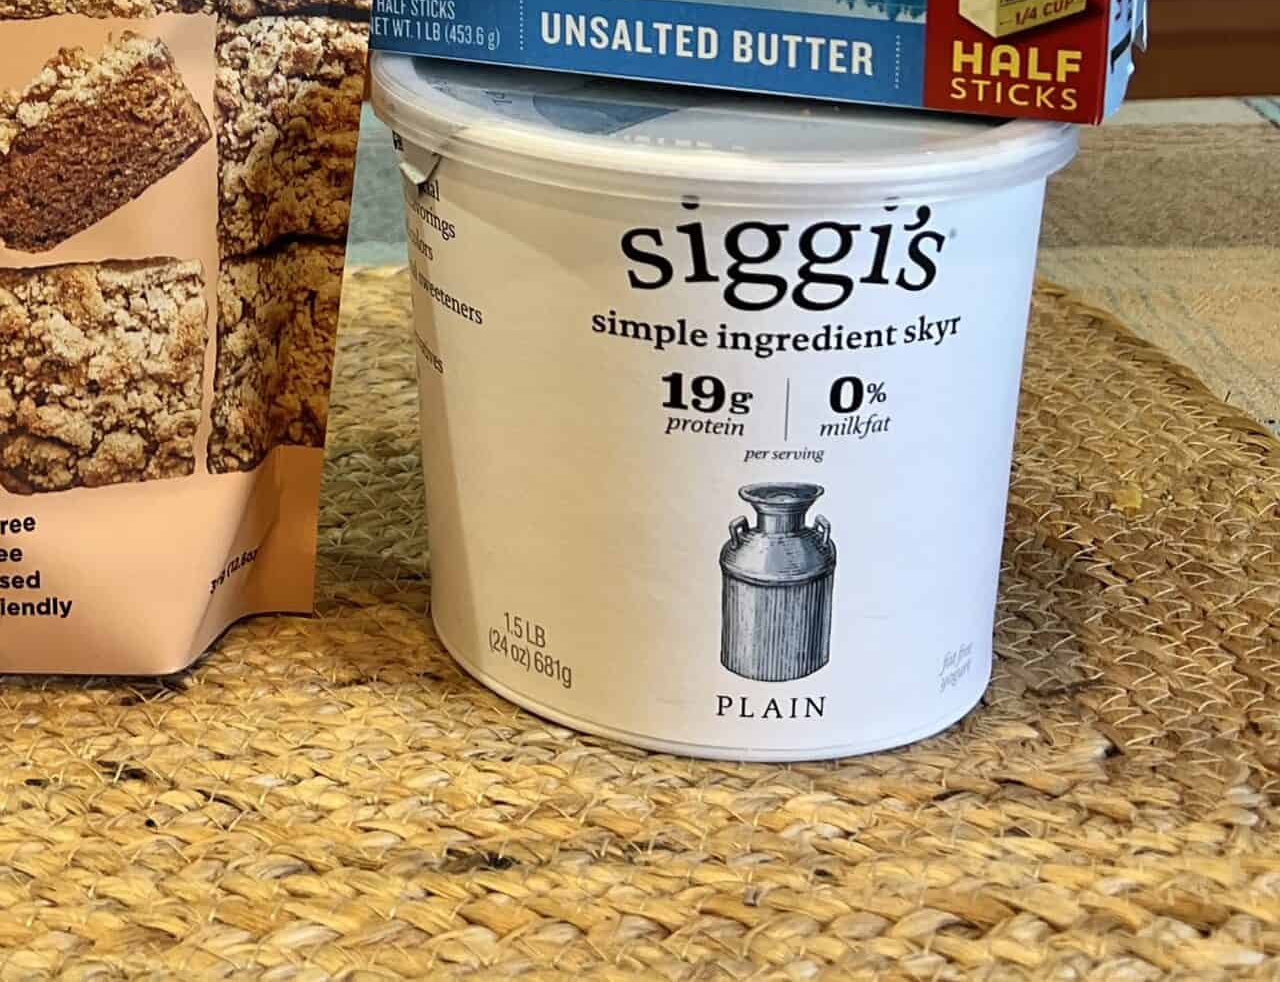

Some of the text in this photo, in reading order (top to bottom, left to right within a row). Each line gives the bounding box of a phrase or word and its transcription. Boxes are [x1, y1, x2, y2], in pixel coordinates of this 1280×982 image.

[1016, 8, 1038, 25] 1/4
[425, 22, 441, 41] LB
[445, 23, 485, 46] (453.6
[540, 11, 874, 76] UNSALTED BUTTER
[952, 40, 1082, 82] HALF
[950, 77, 1078, 111] STICKS
[591, 311, 961, 358] simple ingredient skyr
[664, 415, 745, 438] protein
[819, 414, 892, 440] milkfat
[744, 446, 824, 464] per serving
[504, 612, 546, 648] 1.5 LB
[489, 626, 508, 658] (24
[534, 651, 572, 689] 681g
[716, 695, 827, 719] PLAIN
